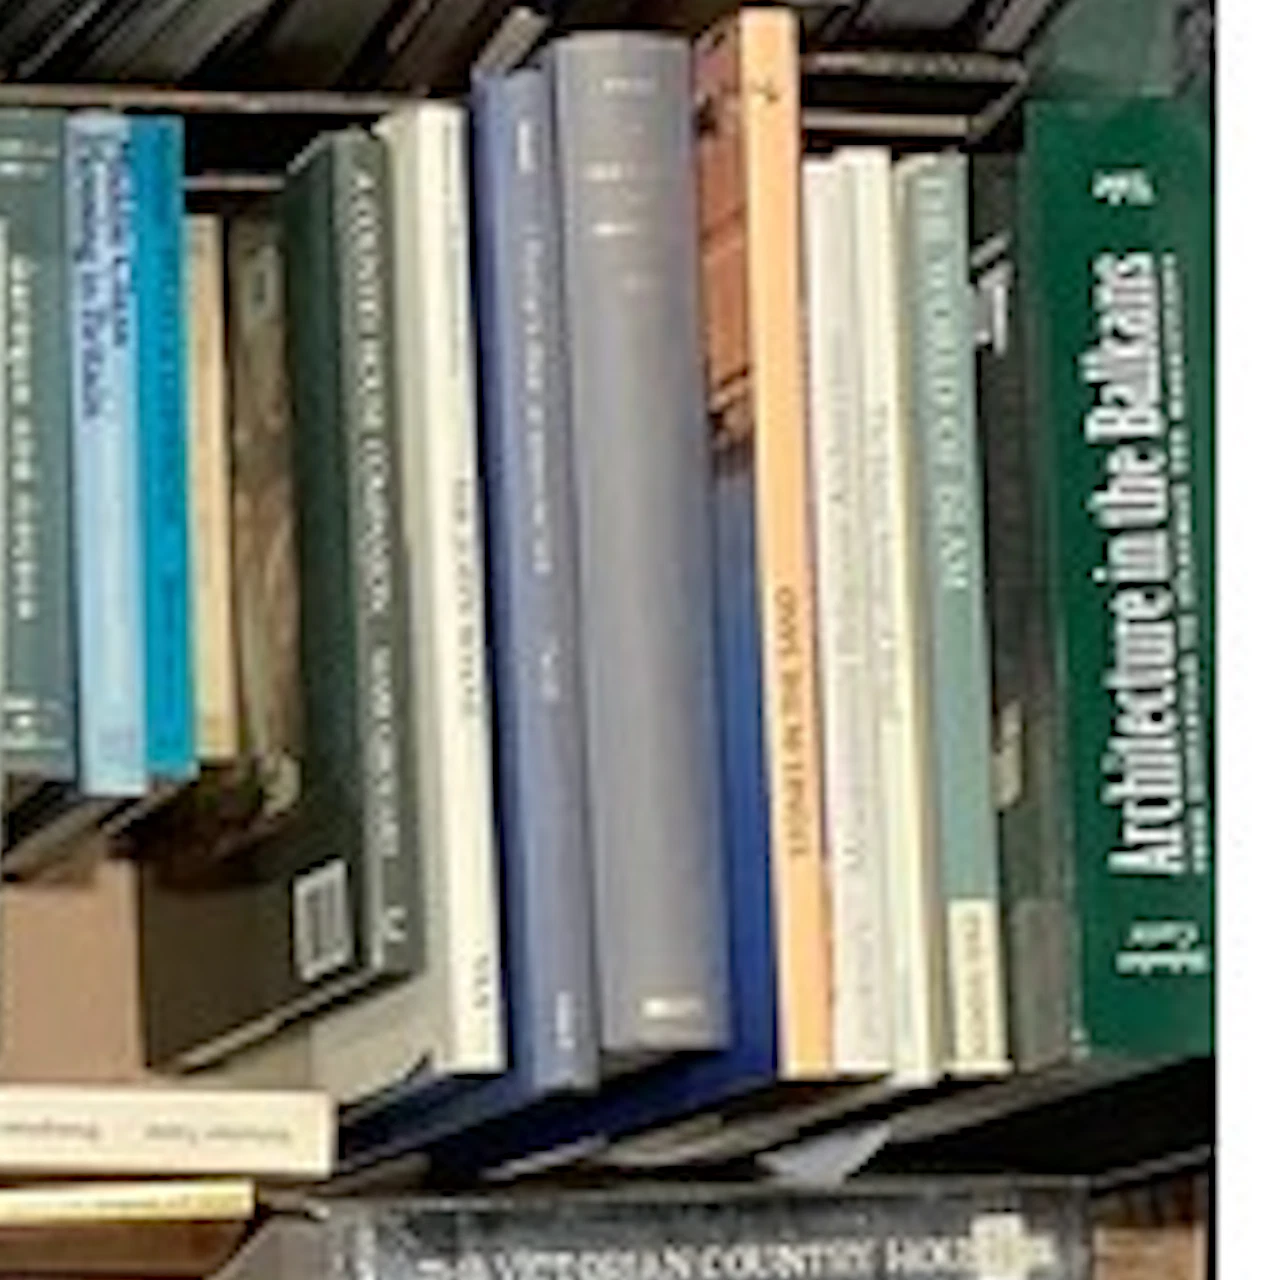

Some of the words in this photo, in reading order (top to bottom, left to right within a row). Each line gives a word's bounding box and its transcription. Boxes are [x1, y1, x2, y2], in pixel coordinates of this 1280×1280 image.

[923, 171, 956, 249] THE
[927, 260, 960, 405] WORLD
[1081, 254, 1165, 442] Balkans
[934, 417, 962, 468] OF
[1089, 446, 1170, 526] the
[937, 484, 970, 591] ISLAM
[1091, 532, 1171, 583] in
[1101, 590, 1187, 875] Architecture
[700, 1238, 872, 1280] COUNTRY
